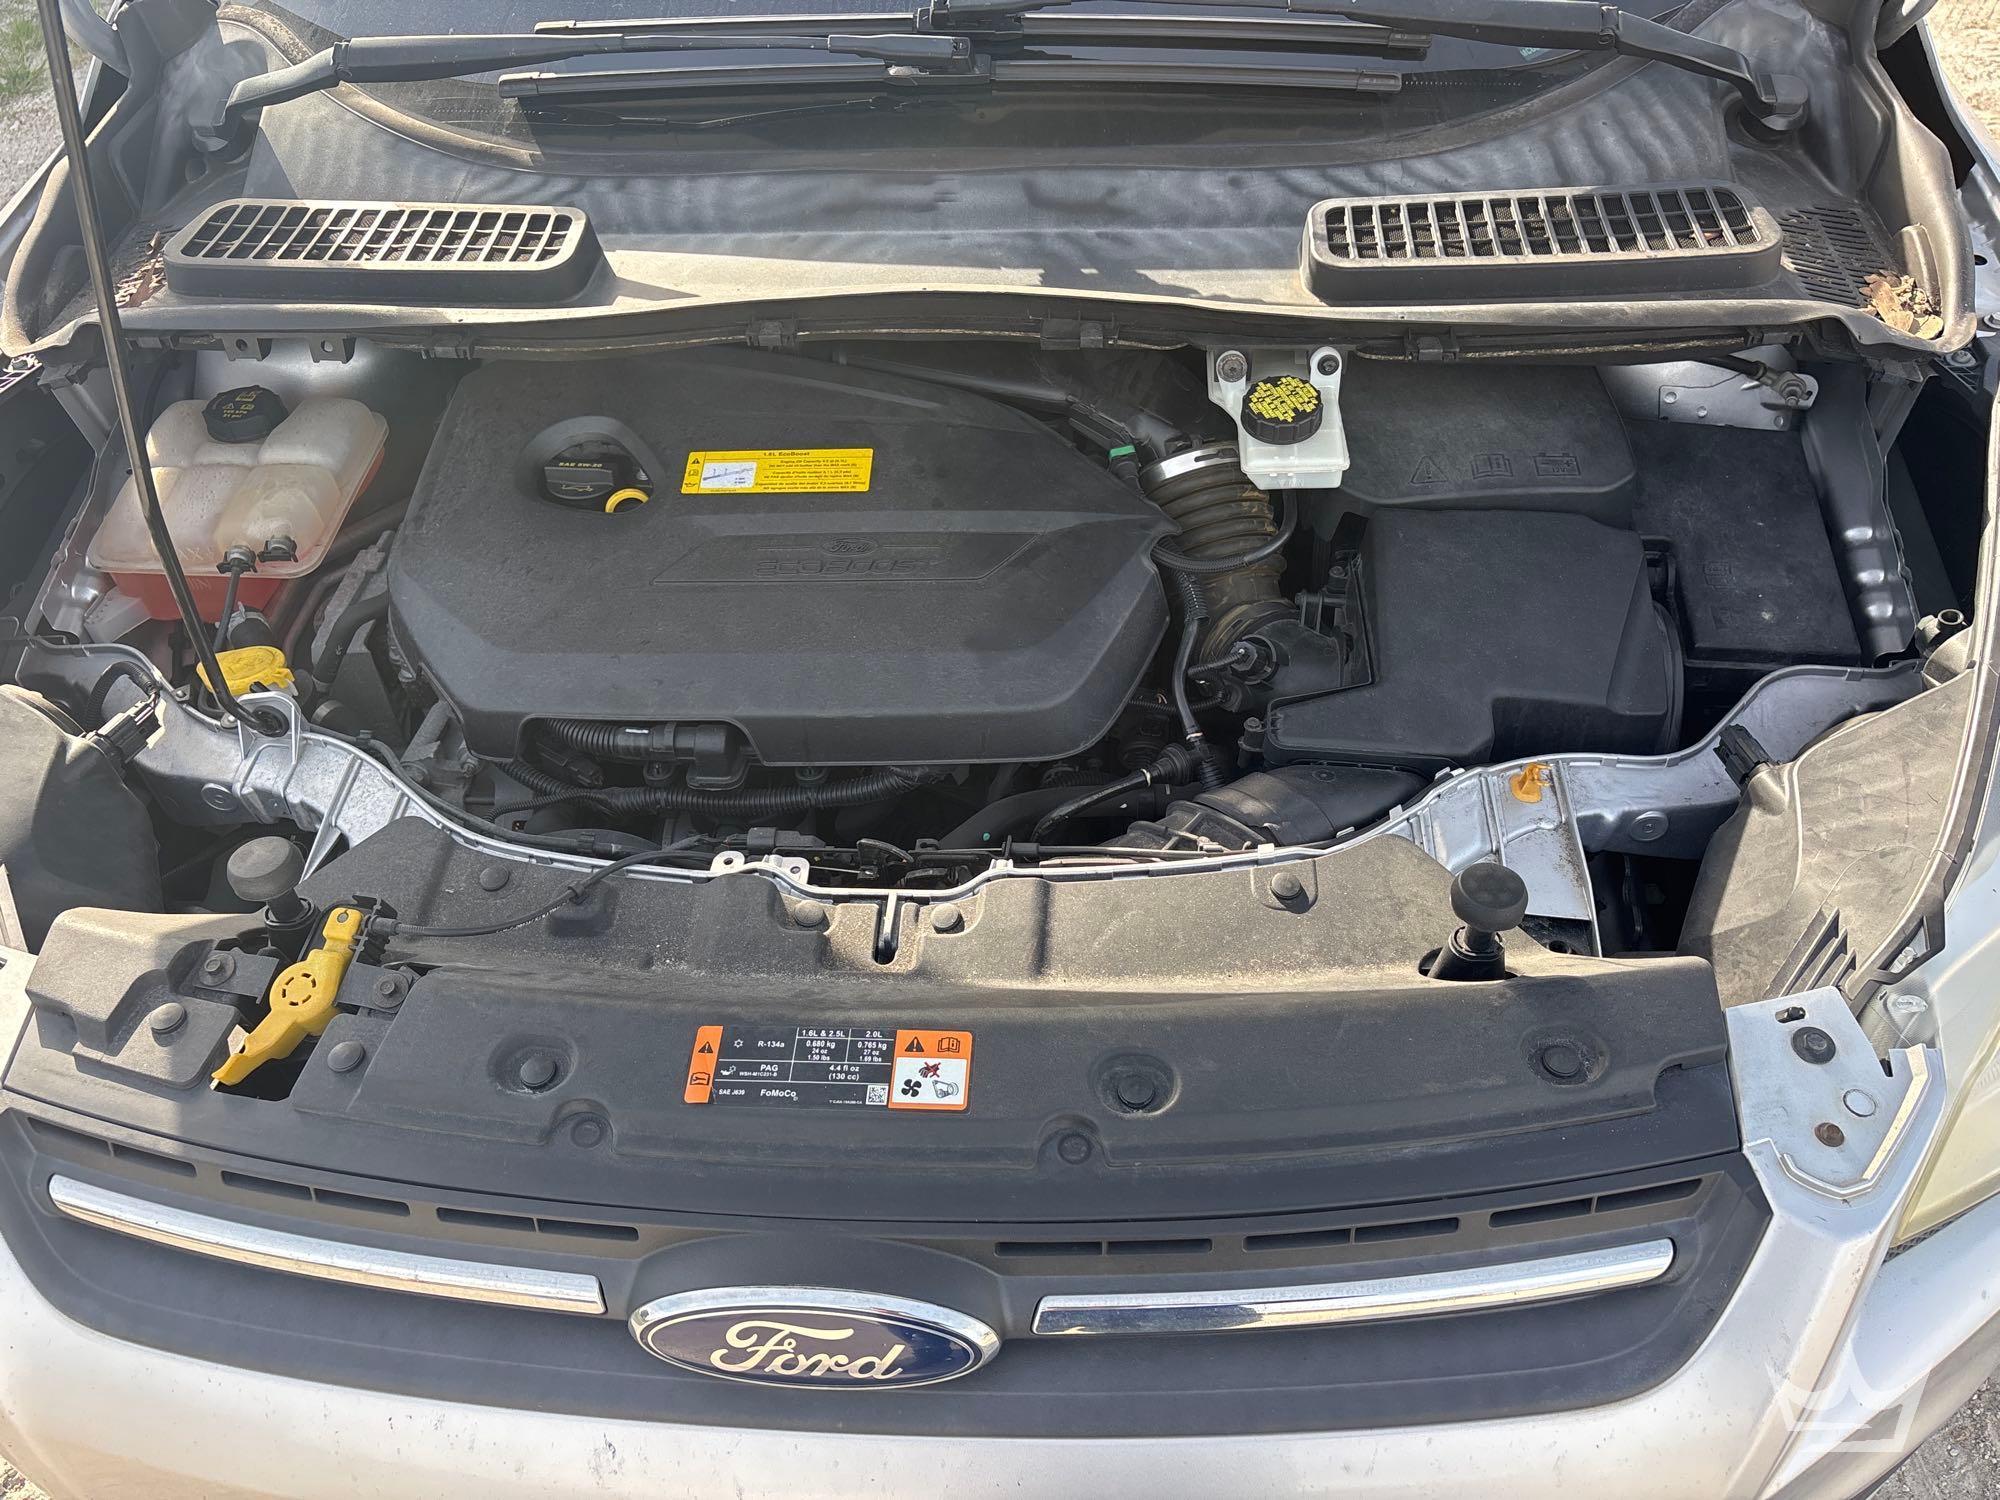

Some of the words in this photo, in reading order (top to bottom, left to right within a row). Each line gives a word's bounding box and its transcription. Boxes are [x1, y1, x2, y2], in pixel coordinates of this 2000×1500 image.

[830, 540, 871, 552] Ford
[802, 1029, 818, 1037] 1.6L
[865, 1030, 882, 1038] 2.0L
[757, 1040, 785, 1048] R-134a
[826, 1040, 836, 1049] kg
[857, 1041, 877, 1049] 0.765
[877, 1042, 887, 1051] kg
[760, 1064, 779, 1072] PAG
[828, 1072, 846, 1080] (130
[846, 1073, 860, 1081] cc)
[760, 1088, 797, 1098] FoMoCo
[709, 1320, 906, 1380] Ford
